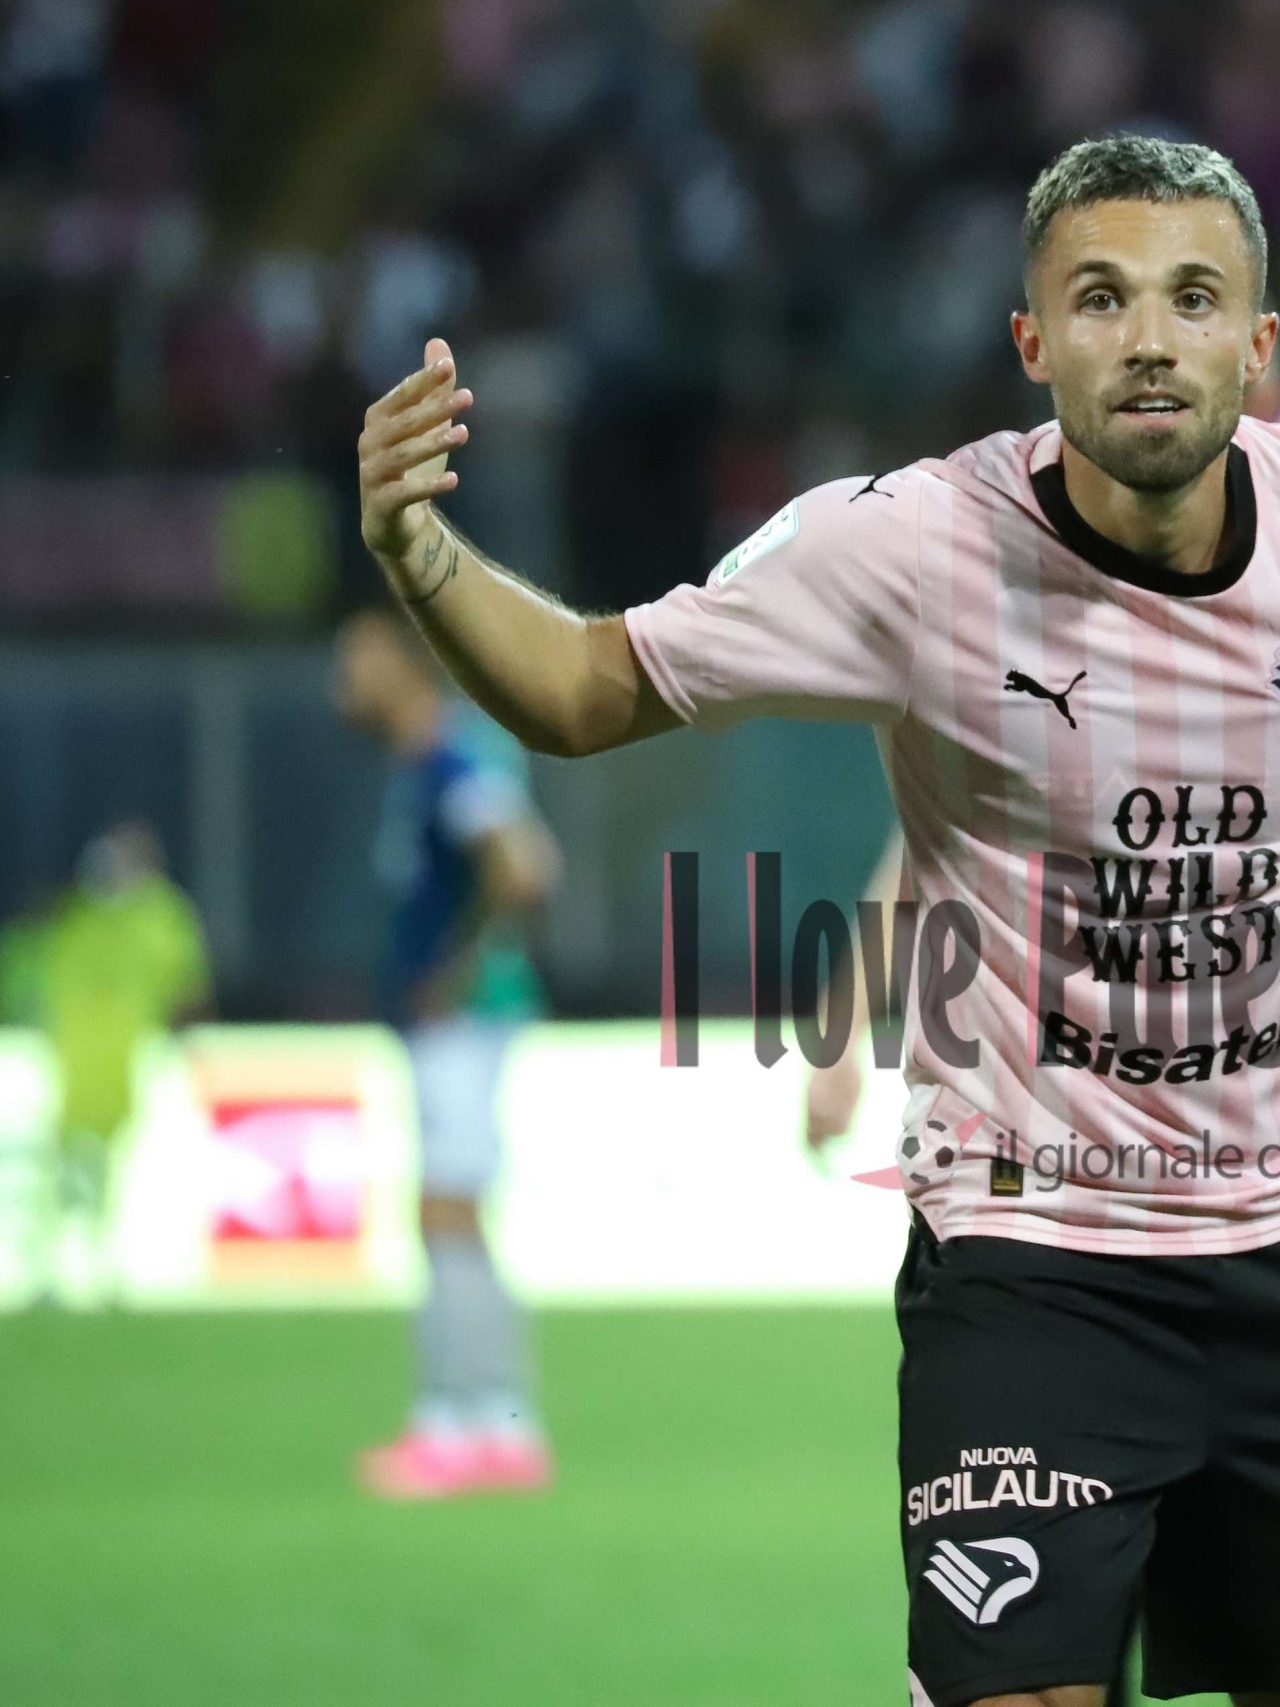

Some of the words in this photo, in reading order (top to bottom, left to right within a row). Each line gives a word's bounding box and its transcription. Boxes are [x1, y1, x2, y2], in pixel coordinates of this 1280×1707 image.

[1112, 785, 1267, 850] OLD
[1089, 848, 1279, 917] WILD
[960, 1447, 1038, 1467] NUOVA
[907, 1469, 1113, 1526] SICILAUTO
